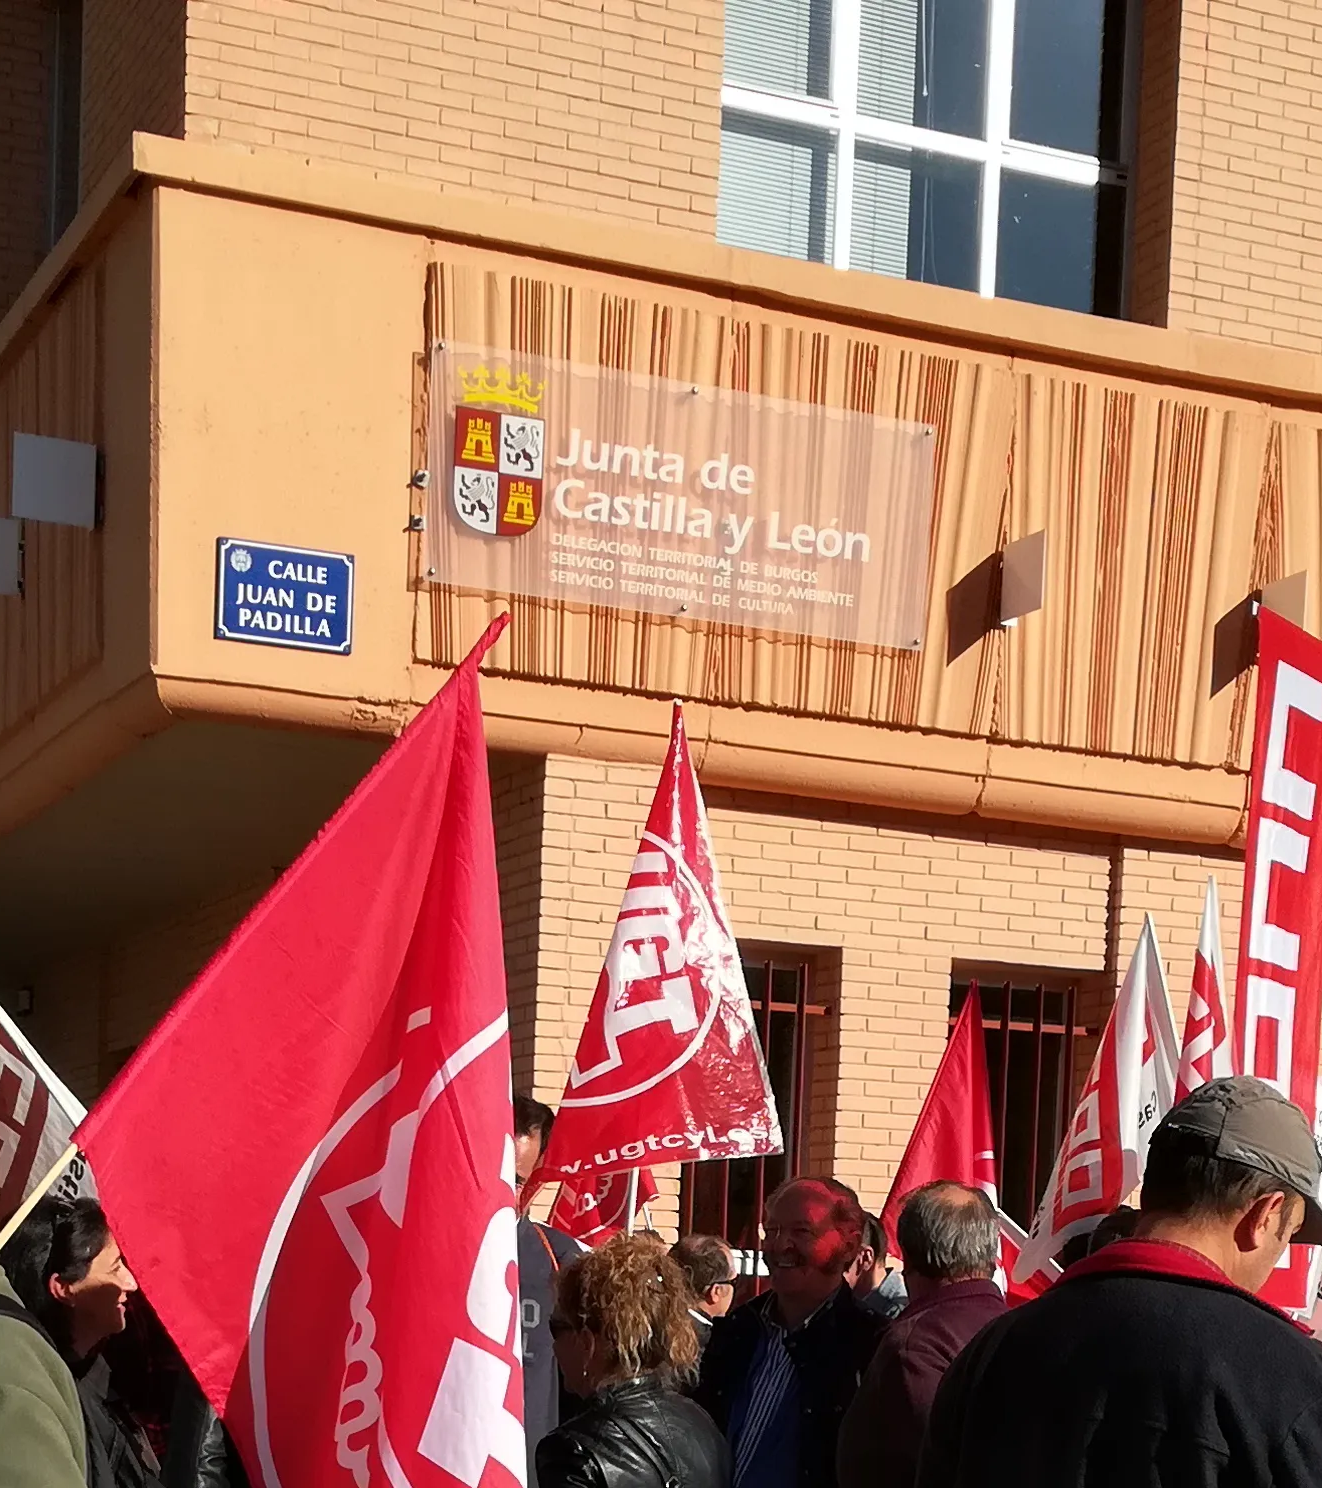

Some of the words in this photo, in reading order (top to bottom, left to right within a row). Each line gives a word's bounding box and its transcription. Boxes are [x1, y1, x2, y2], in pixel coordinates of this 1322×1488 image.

[556, 427, 685, 484] Junta
[700, 453, 755, 495] de
[554, 478, 713, 538] Castilla
[724, 512, 755, 555] y
[767, 511, 871, 563] León
[267, 560, 328, 585] CALLE
[550, 532, 643, 559] DELEGACION
[649, 547, 734, 571] TERRITORIAL
[740, 561, 758, 575] DE
[764, 563, 819, 584] BURGOS
[550, 551, 615, 572] SERVICIO
[620, 561, 707, 586] TERRITORIAL
[713, 574, 731, 589] DE
[737, 578, 782, 597] MEDIO
[786, 586, 855, 607] AMBIENTE
[235, 582, 295, 609] JUAN
[306, 592, 337, 614] DE
[549, 569, 614, 591] SERVICIO
[619, 579, 706, 604] TERRITORIAL
[712, 593, 731, 608] DE
[738, 597, 795, 615] CULTURA
[238, 607, 332, 638] PADILLA
